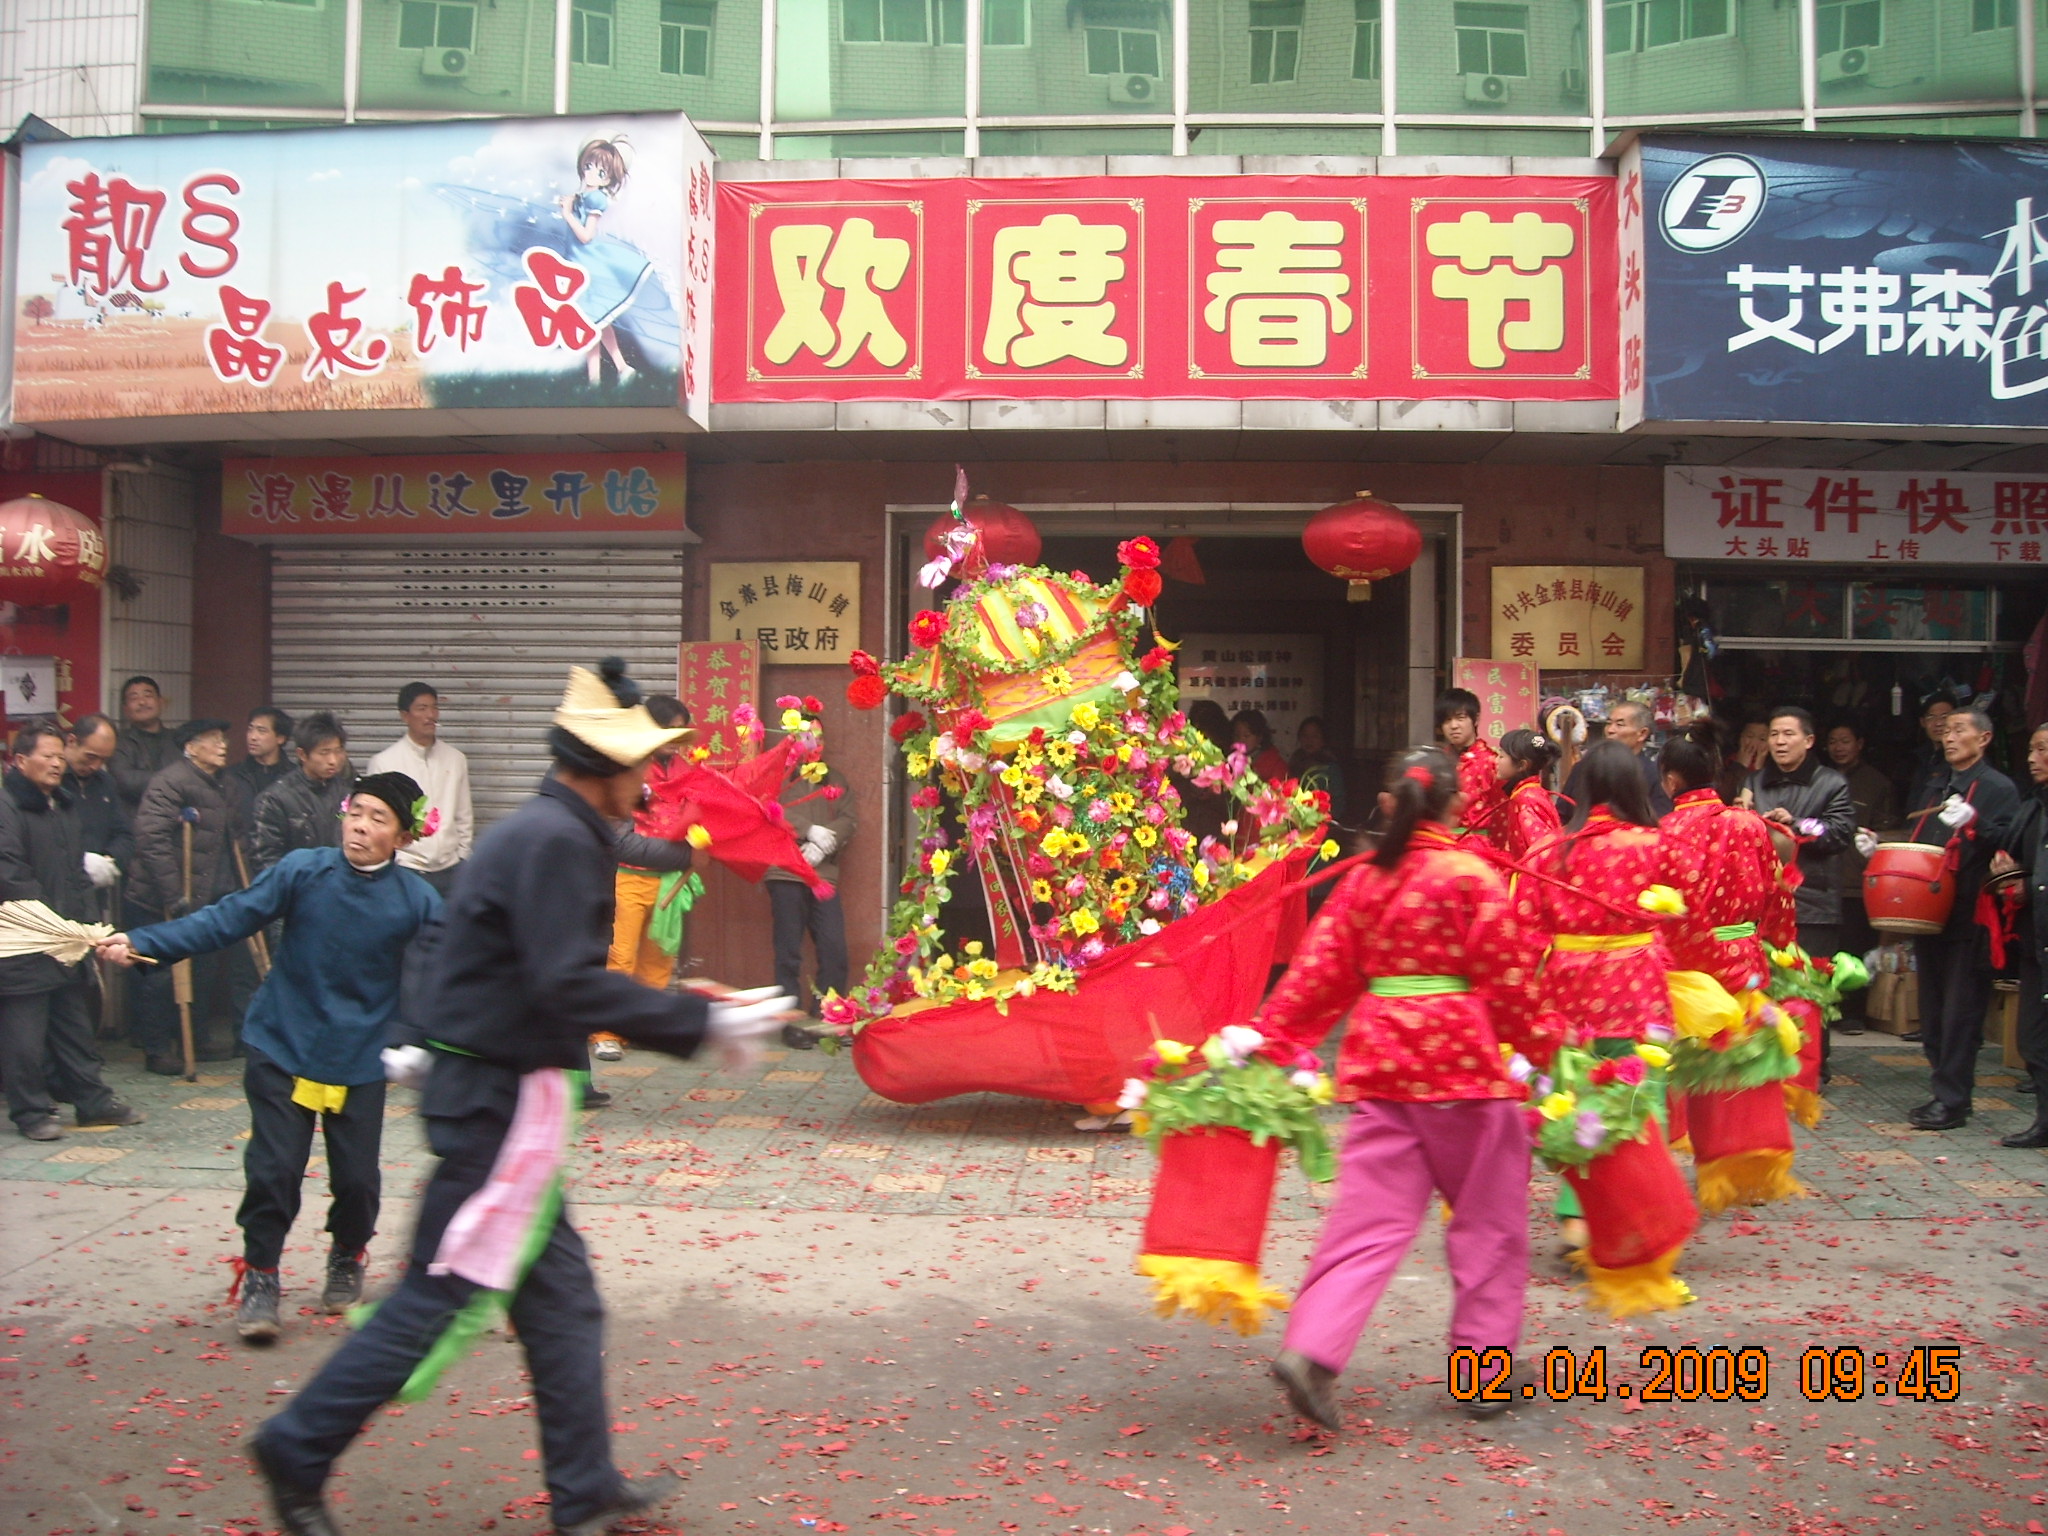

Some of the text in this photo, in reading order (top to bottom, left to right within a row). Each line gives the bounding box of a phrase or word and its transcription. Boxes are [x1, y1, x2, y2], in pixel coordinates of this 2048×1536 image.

[764, 211, 1574, 369] 欢度春节
[1624, 170, 1640, 395] 大头贴
[1727, 263, 1993, 358] 艾弗森
[246, 467, 659, 523] 浪漫从这里开始
[1712, 475, 2048, 536] 证件快照
[1725, 536, 2042, 563] 大头贴 上传 下载
[719, 573, 851, 620] 金寨县梅山镇
[1502, 578, 1634, 622] 中共金寨县梅山镇
[1786, 581, 1964, 627] 大头贴
[1511, 632, 1626, 656] 委员会
[704, 648, 731, 754] 恭贺新春
